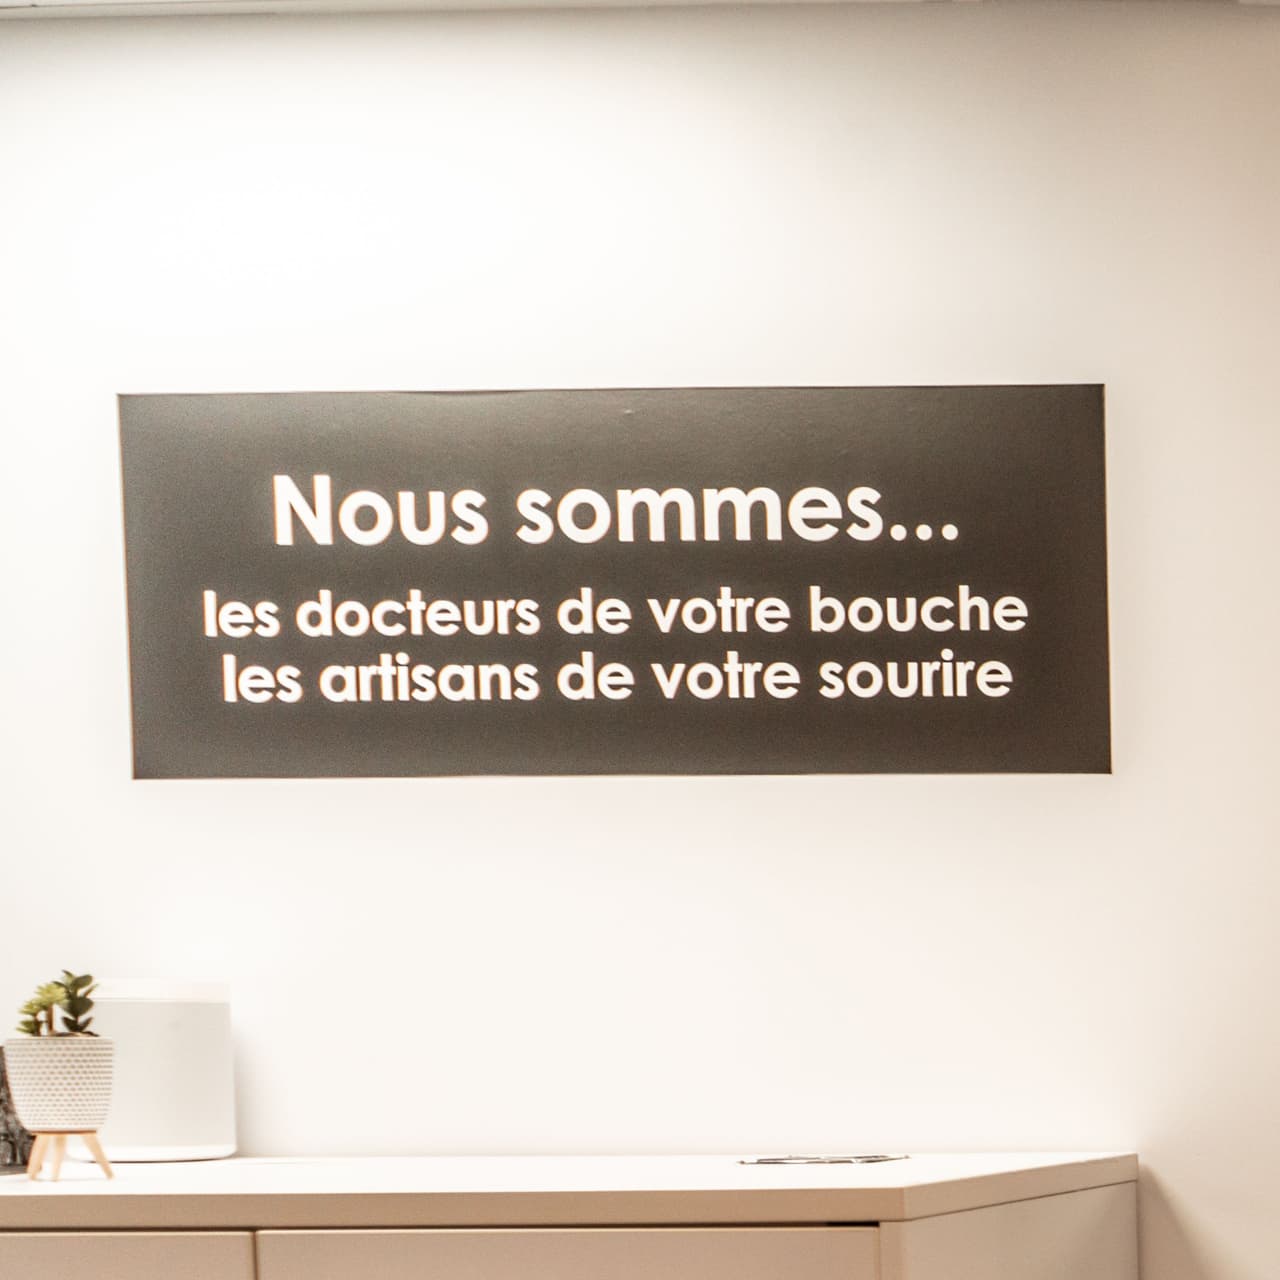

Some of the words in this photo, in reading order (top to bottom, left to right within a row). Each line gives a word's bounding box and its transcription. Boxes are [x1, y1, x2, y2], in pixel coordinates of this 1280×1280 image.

[271, 473, 488, 547] Nous
[515, 483, 959, 544] sommes...
[202, 590, 280, 638] les
[296, 588, 540, 637] docteurs
[557, 587, 632, 635] de
[648, 593, 791, 634] votre
[809, 585, 1029, 633] bouche
[222, 654, 303, 703] les
[319, 652, 540, 701] artisans
[557, 650, 635, 700] de
[651, 657, 800, 699] votre
[818, 648, 1013, 698] sourire
